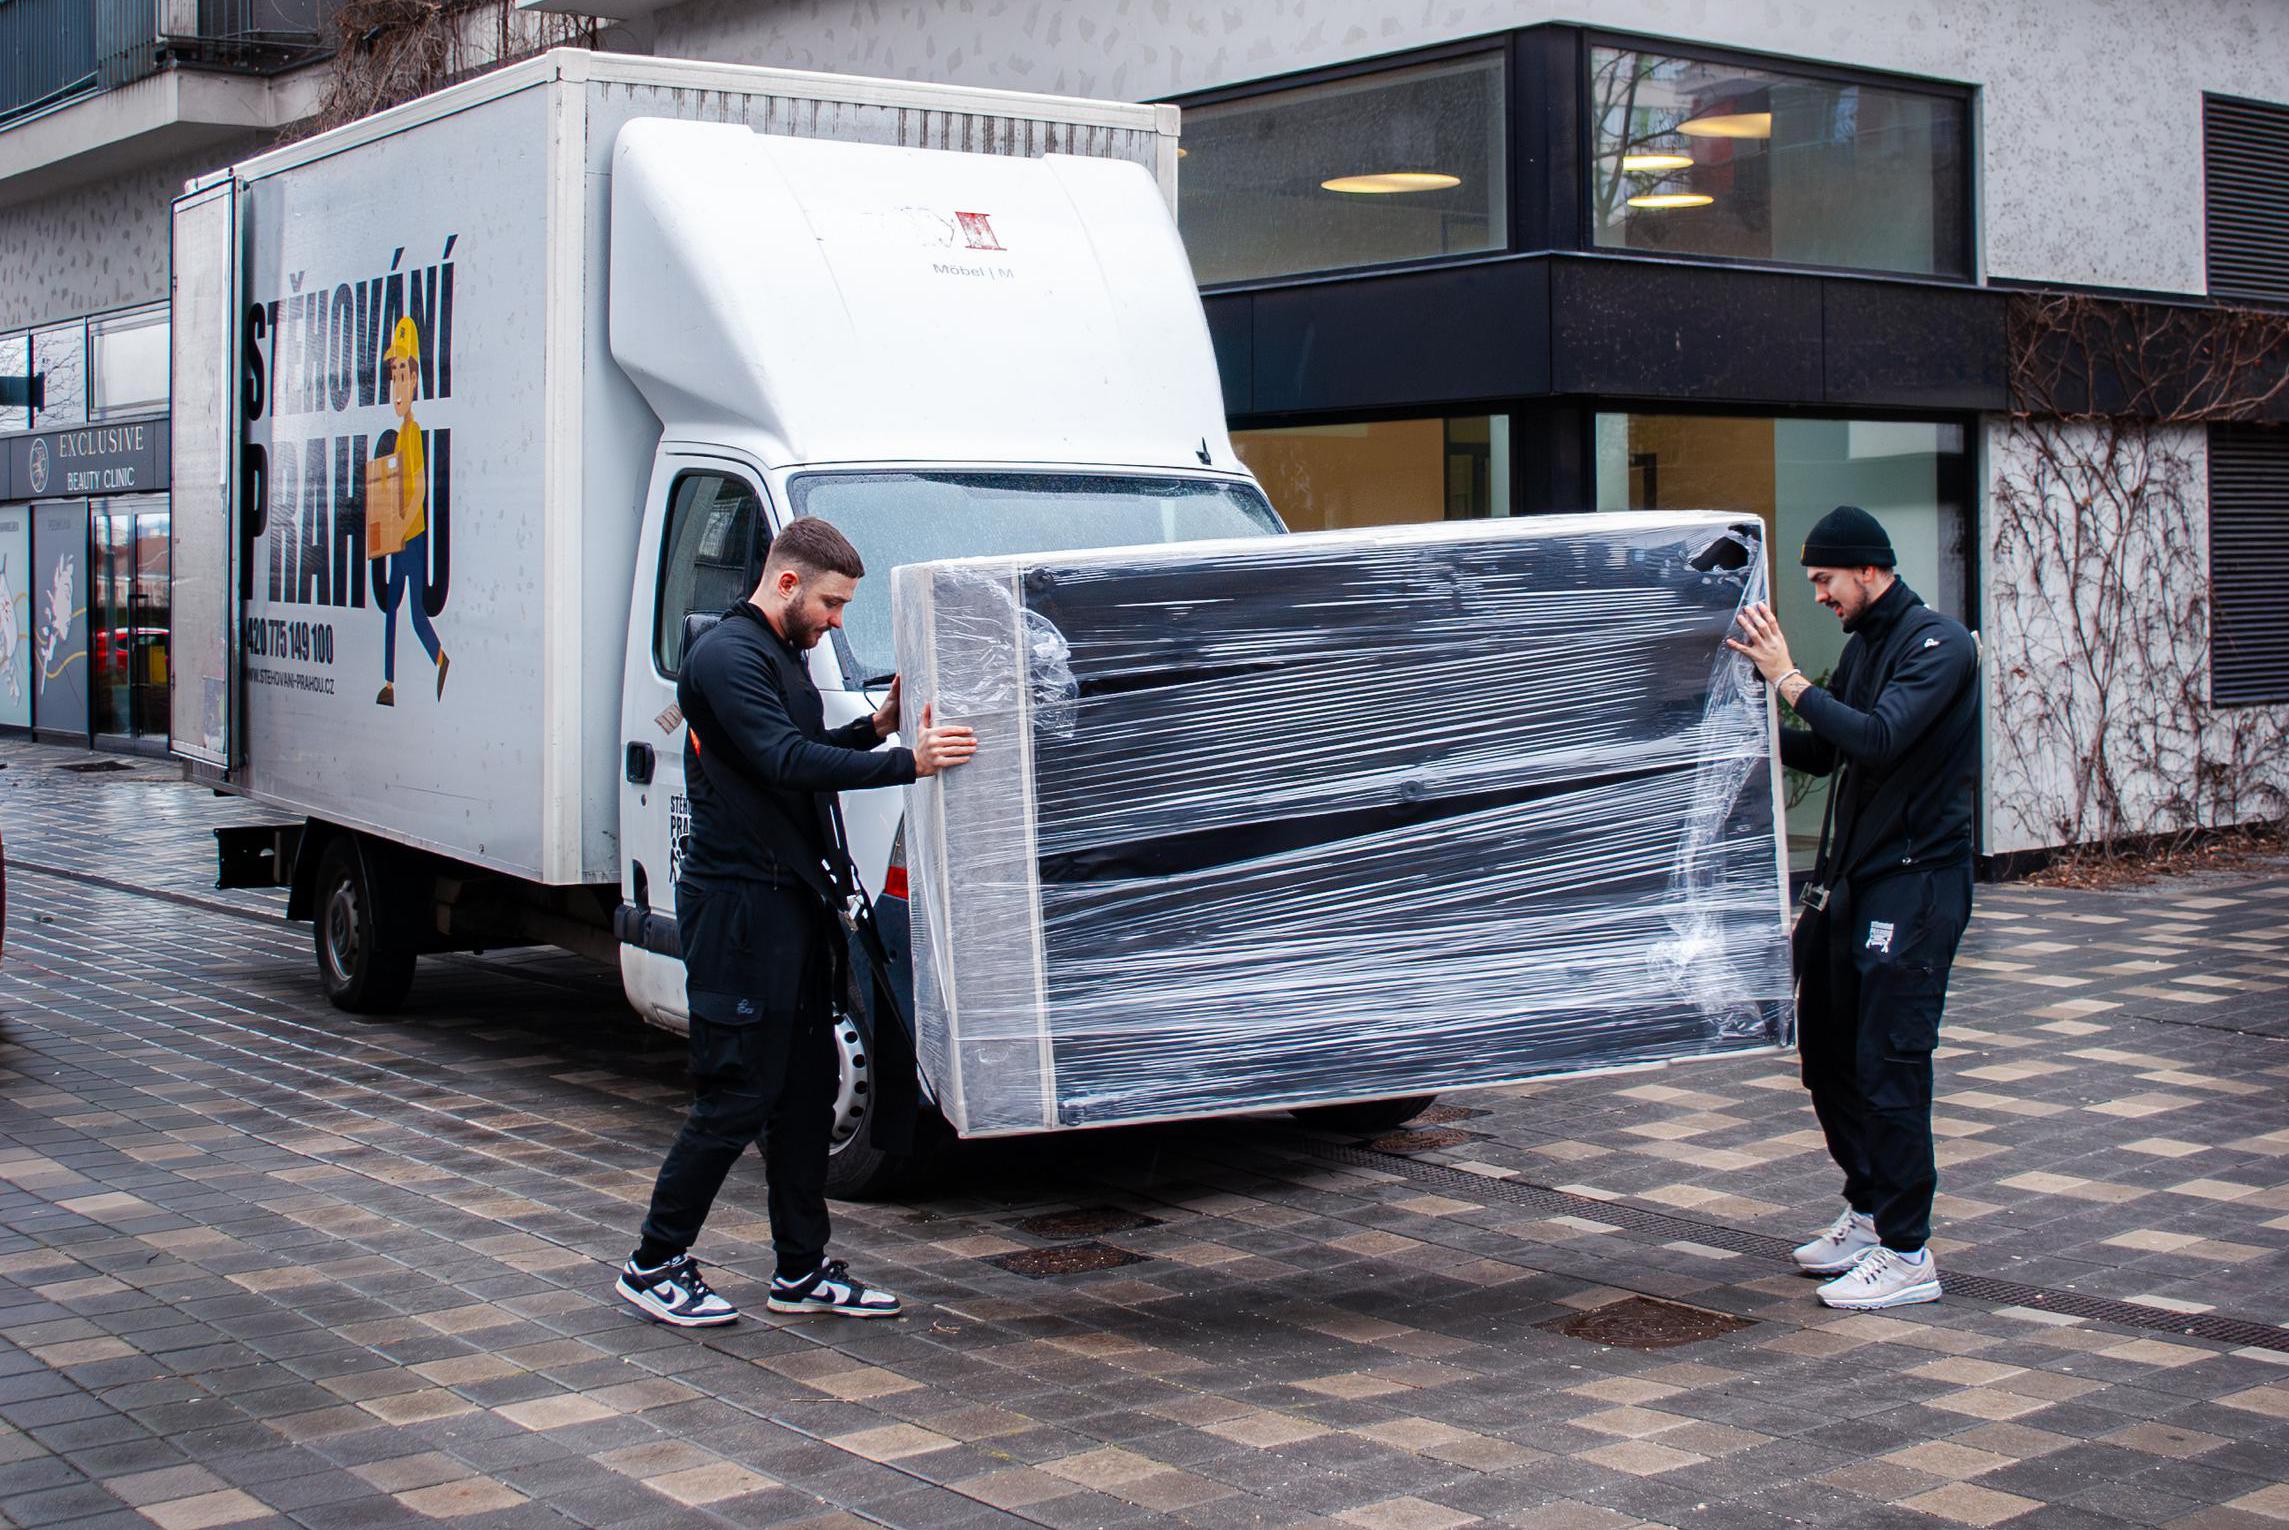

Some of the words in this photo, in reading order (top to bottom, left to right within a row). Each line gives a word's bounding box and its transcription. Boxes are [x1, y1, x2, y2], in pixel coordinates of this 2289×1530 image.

[932, 263, 985, 276] Möbel
[247, 234, 458, 421] STĚHOVÁNÍ
[60, 426, 144, 457] EXCLUSIVE
[67, 470, 101, 491] BEAUTY
[103, 467, 135, 488] CLINIC
[245, 617, 267, 656] 420
[268, 619, 287, 658] 775
[289, 621, 309, 661] 149
[311, 623, 334, 664] 100
[670, 815, 690, 838] PRA
